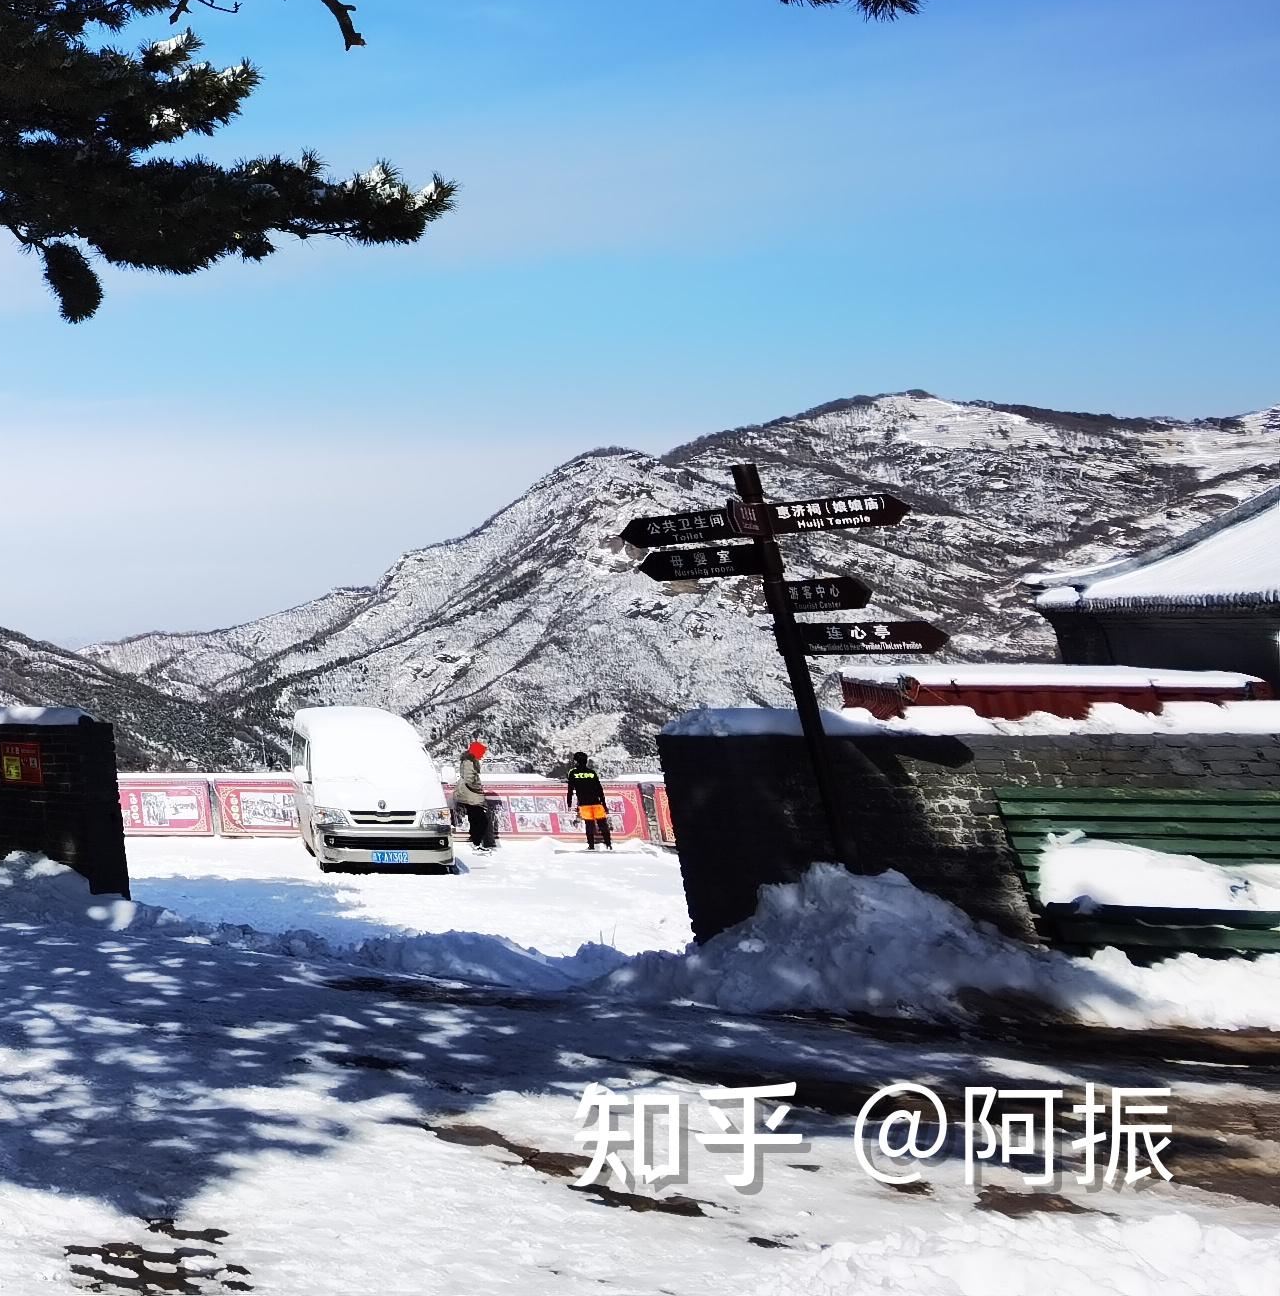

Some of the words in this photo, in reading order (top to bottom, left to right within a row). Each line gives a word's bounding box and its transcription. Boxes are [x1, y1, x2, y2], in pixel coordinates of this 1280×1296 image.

[647, 514, 724, 534] 公共卫生间
[797, 519, 825, 529] Huiji
[827, 514, 871, 526] Temple
[672, 532, 703, 542] Toilet
[670, 550, 733, 567] 母婴室
[674, 567, 709, 577] Nursing
[710, 565, 735, 575] room
[788, 584, 840, 600] 游客中心
[794, 602, 818, 610] Tourist
[819, 600, 841, 609] Center
[826, 624, 891, 640] 连心亭
